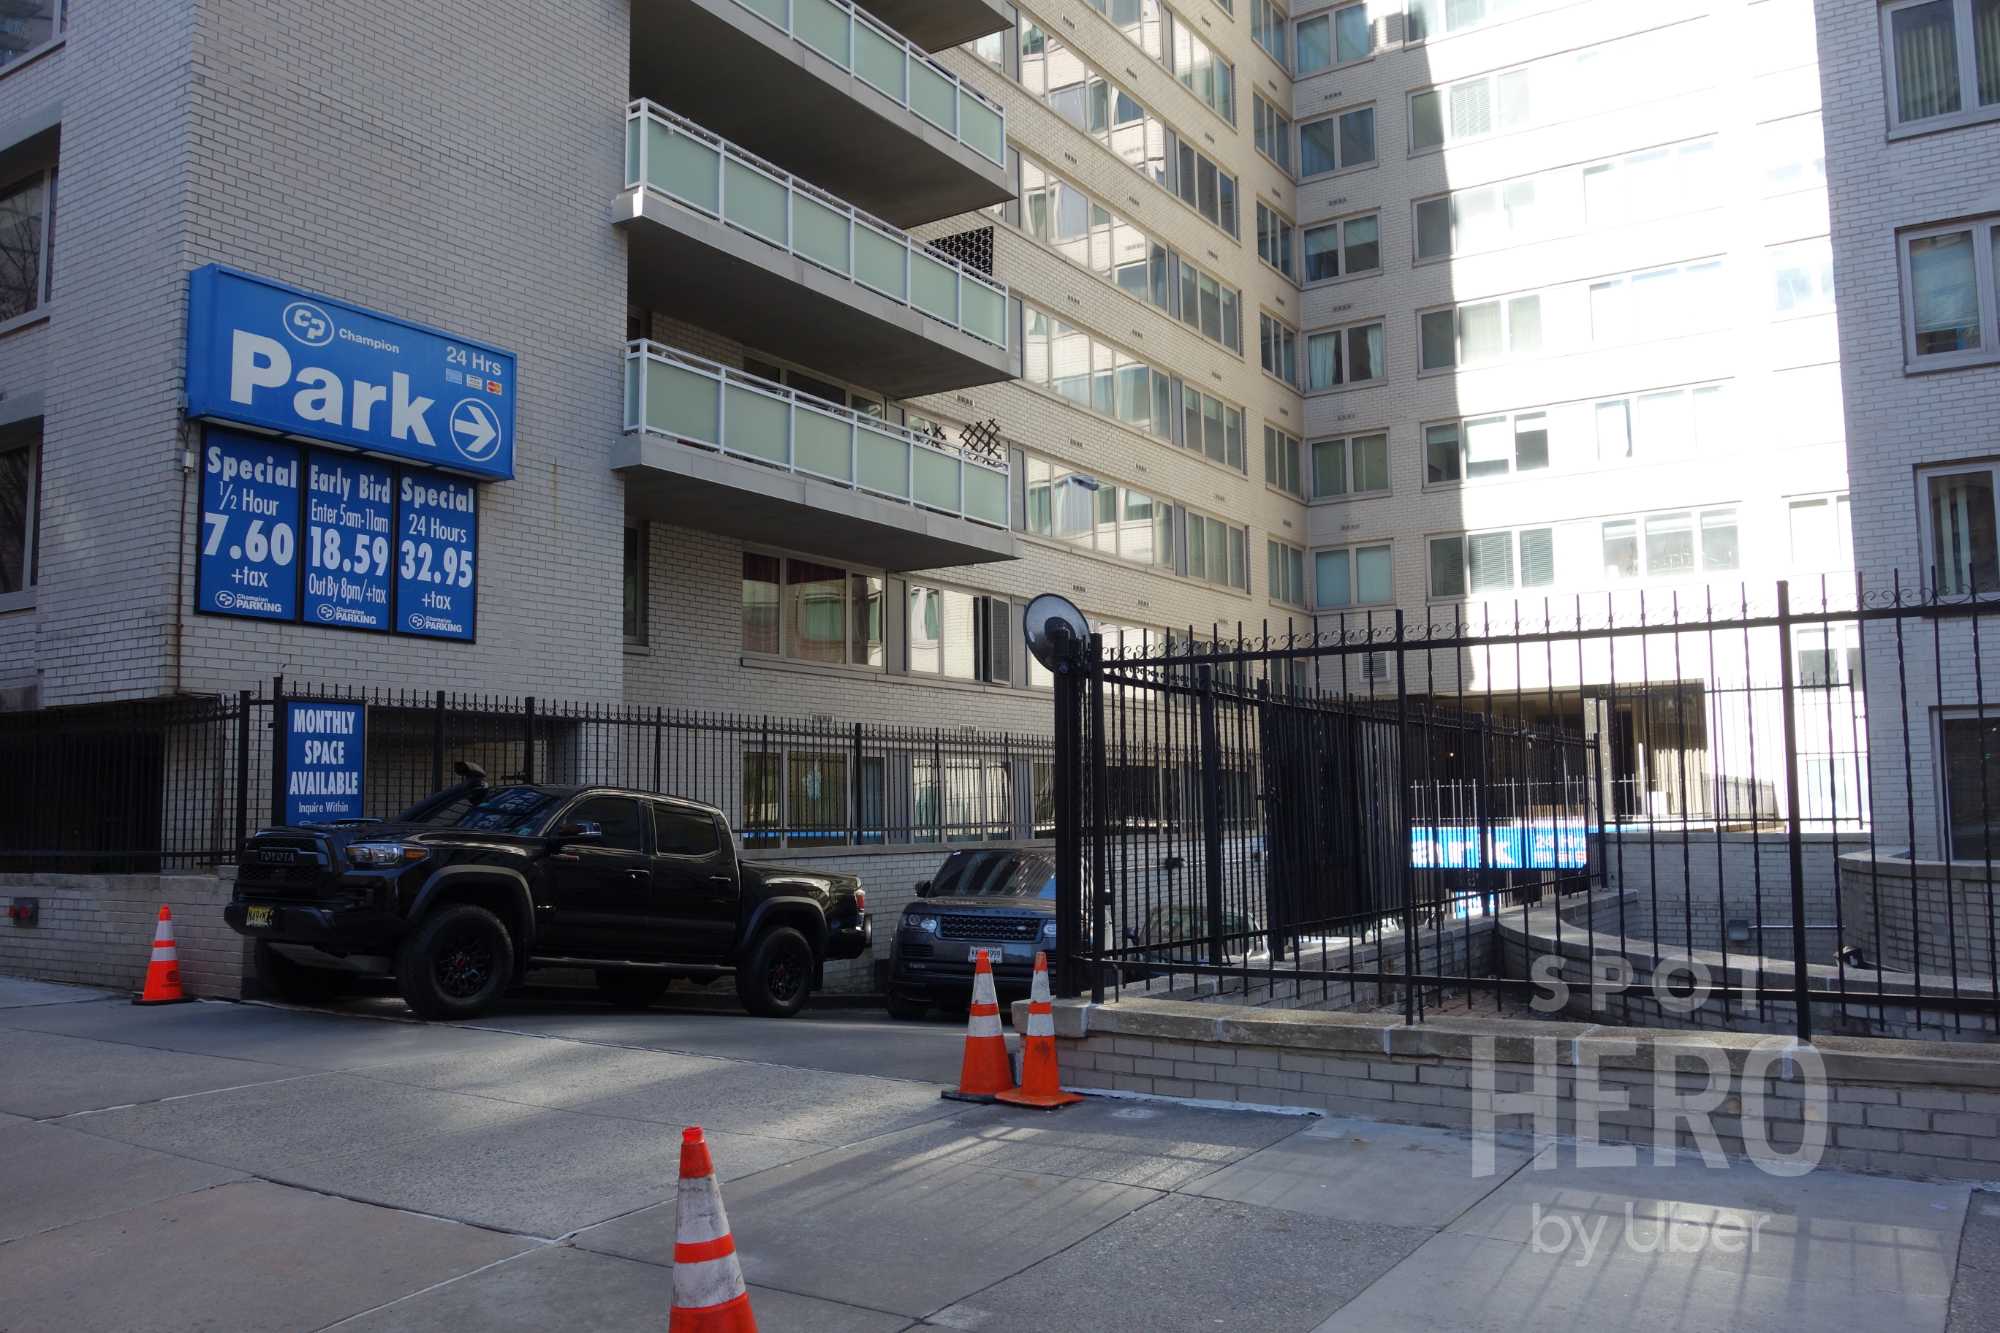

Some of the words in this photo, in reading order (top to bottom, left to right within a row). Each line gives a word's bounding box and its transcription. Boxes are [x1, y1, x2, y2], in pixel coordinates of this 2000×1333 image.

[338, 327, 400, 354] Champion
[446, 346, 467, 366] 24
[472, 352, 502, 376] Hrs
[230, 328, 437, 448] Park
[207, 446, 298, 489] Special
[310, 464, 352, 502] Early
[360, 473, 391, 504] Bird
[401, 476, 474, 513] Special
[242, 487, 280, 517] Hour
[311, 498, 338, 525] Enter
[340, 503, 389, 534] 5am-11am
[203, 511, 295, 566] 7.60
[409, 513, 426, 537] 24
[430, 516, 467, 543] Hours
[310, 526, 389, 577] 18.59
[400, 539, 473, 588] 32.95
[231, 565, 269, 588] +tax
[308, 572, 326, 596] Out
[327, 575, 339, 603] By
[236, 599, 282, 613] PARKING
[421, 590, 452, 611] +tax
[336, 611, 377, 625] PARKING
[425, 620, 463, 633] PARKING
[293, 708, 355, 735] MONTHLY
[304, 739, 345, 765] SPACE
[289, 771, 359, 796] AVAILABLE
[298, 801, 324, 815] Inquire
[325, 801, 349, 813] Within
[1411, 826, 1516, 867] ark
